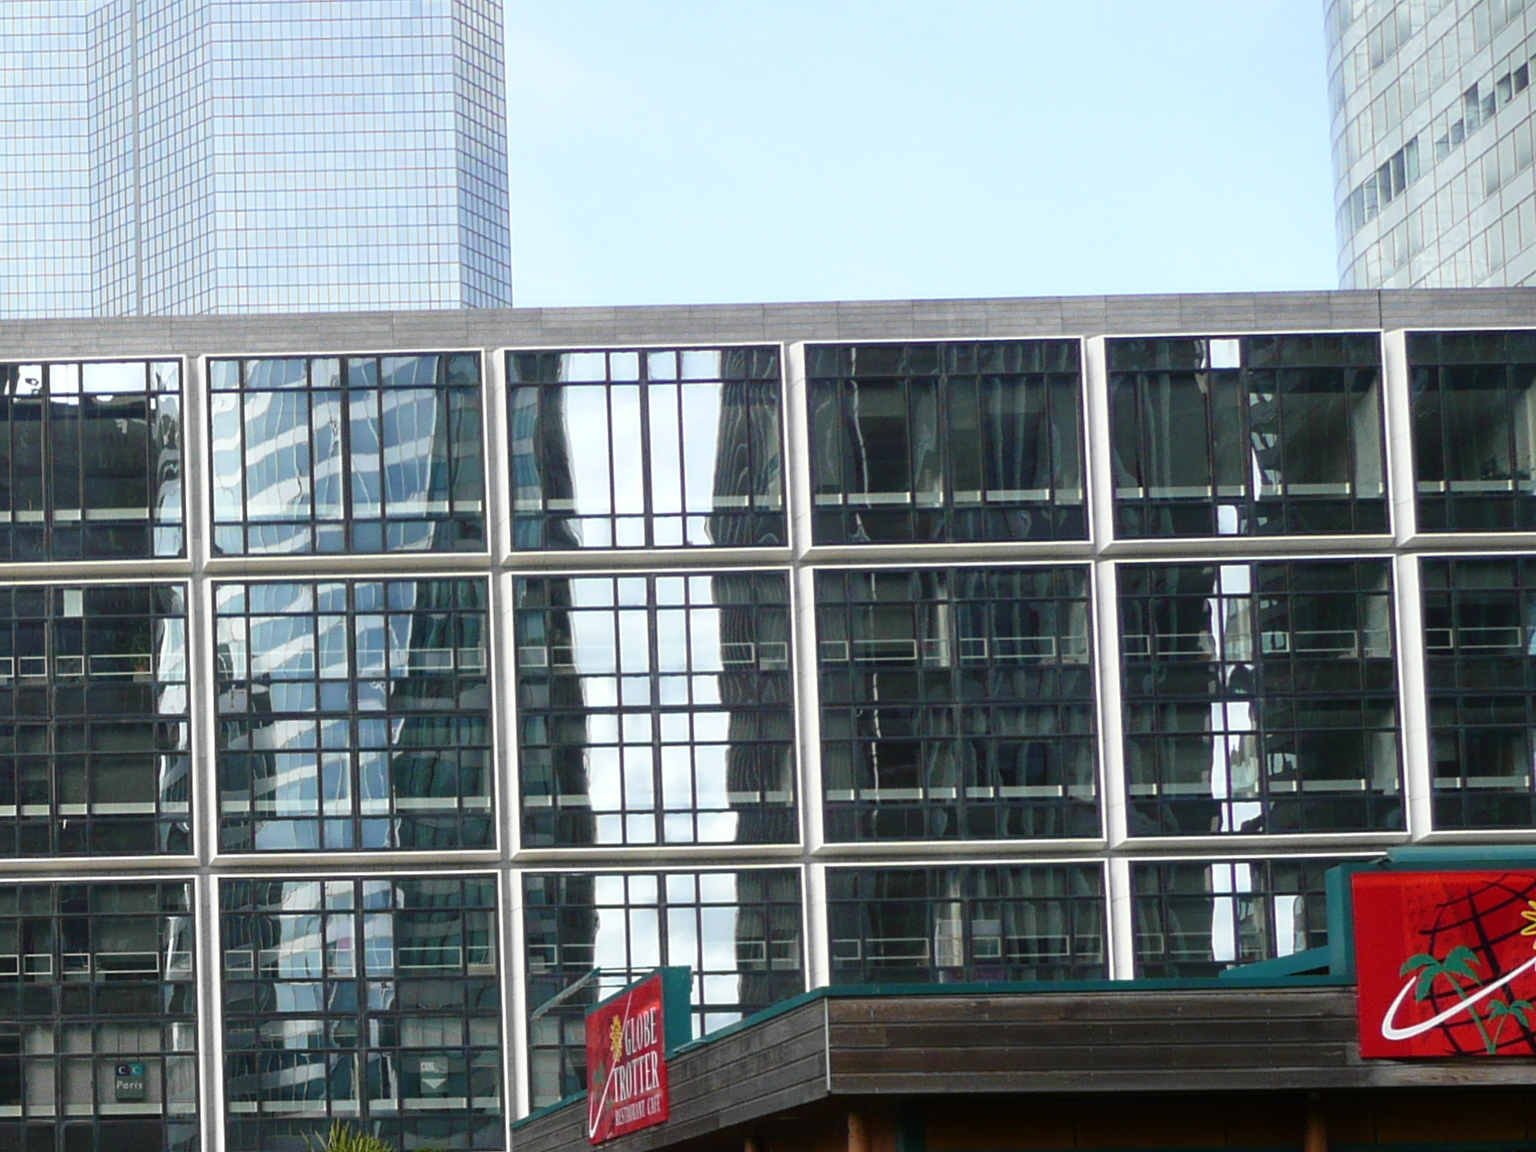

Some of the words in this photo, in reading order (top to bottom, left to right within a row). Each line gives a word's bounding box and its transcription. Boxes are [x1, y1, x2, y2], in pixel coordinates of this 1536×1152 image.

[625, 1007, 657, 1056] GLOBE
[116, 1080, 143, 1090] Paris
[613, 1051, 659, 1102] TROTTER
